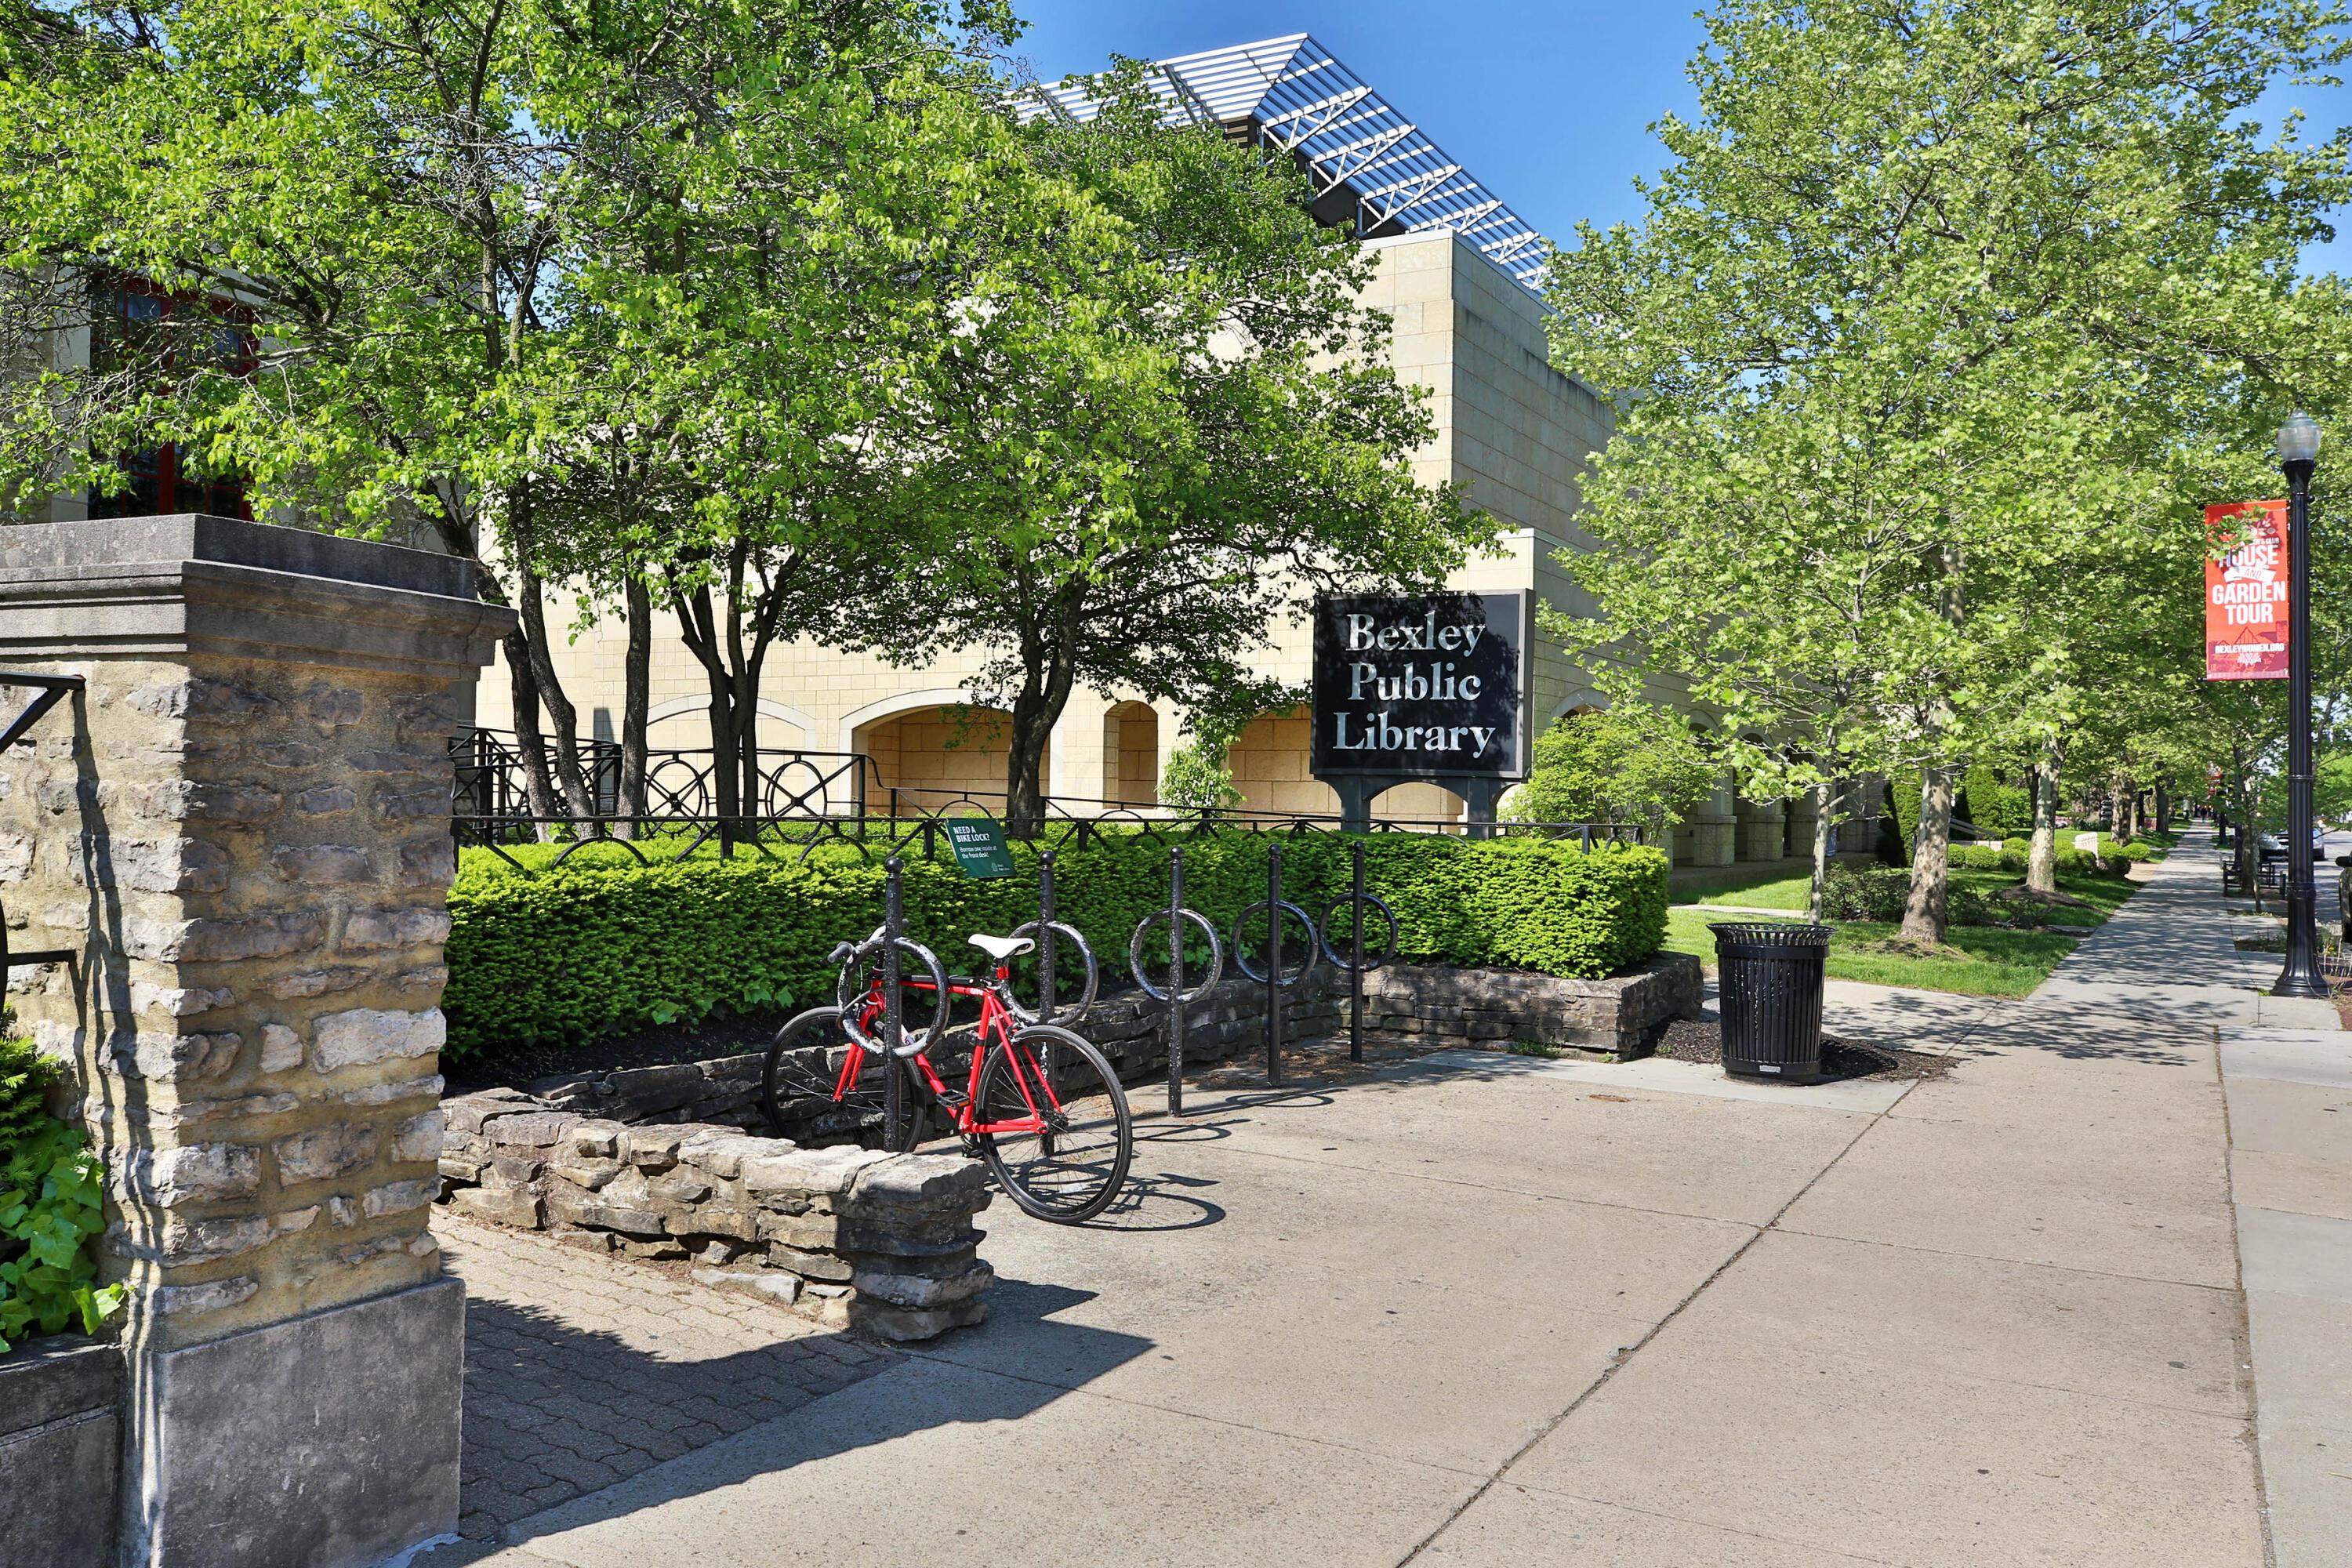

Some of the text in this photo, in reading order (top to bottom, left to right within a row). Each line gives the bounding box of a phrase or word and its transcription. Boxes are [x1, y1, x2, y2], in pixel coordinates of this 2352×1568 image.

[2244, 568, 2262, 579] AND
[2212, 581, 2286, 605] GARDEN
[2224, 602, 2274, 626] TOUR
[1345, 610, 1486, 657] Bexley
[1348, 661, 1482, 701] Public
[1333, 710, 1497, 758] Library
[953, 826, 971, 834] NEED
[956, 834, 971, 843] BIKE
